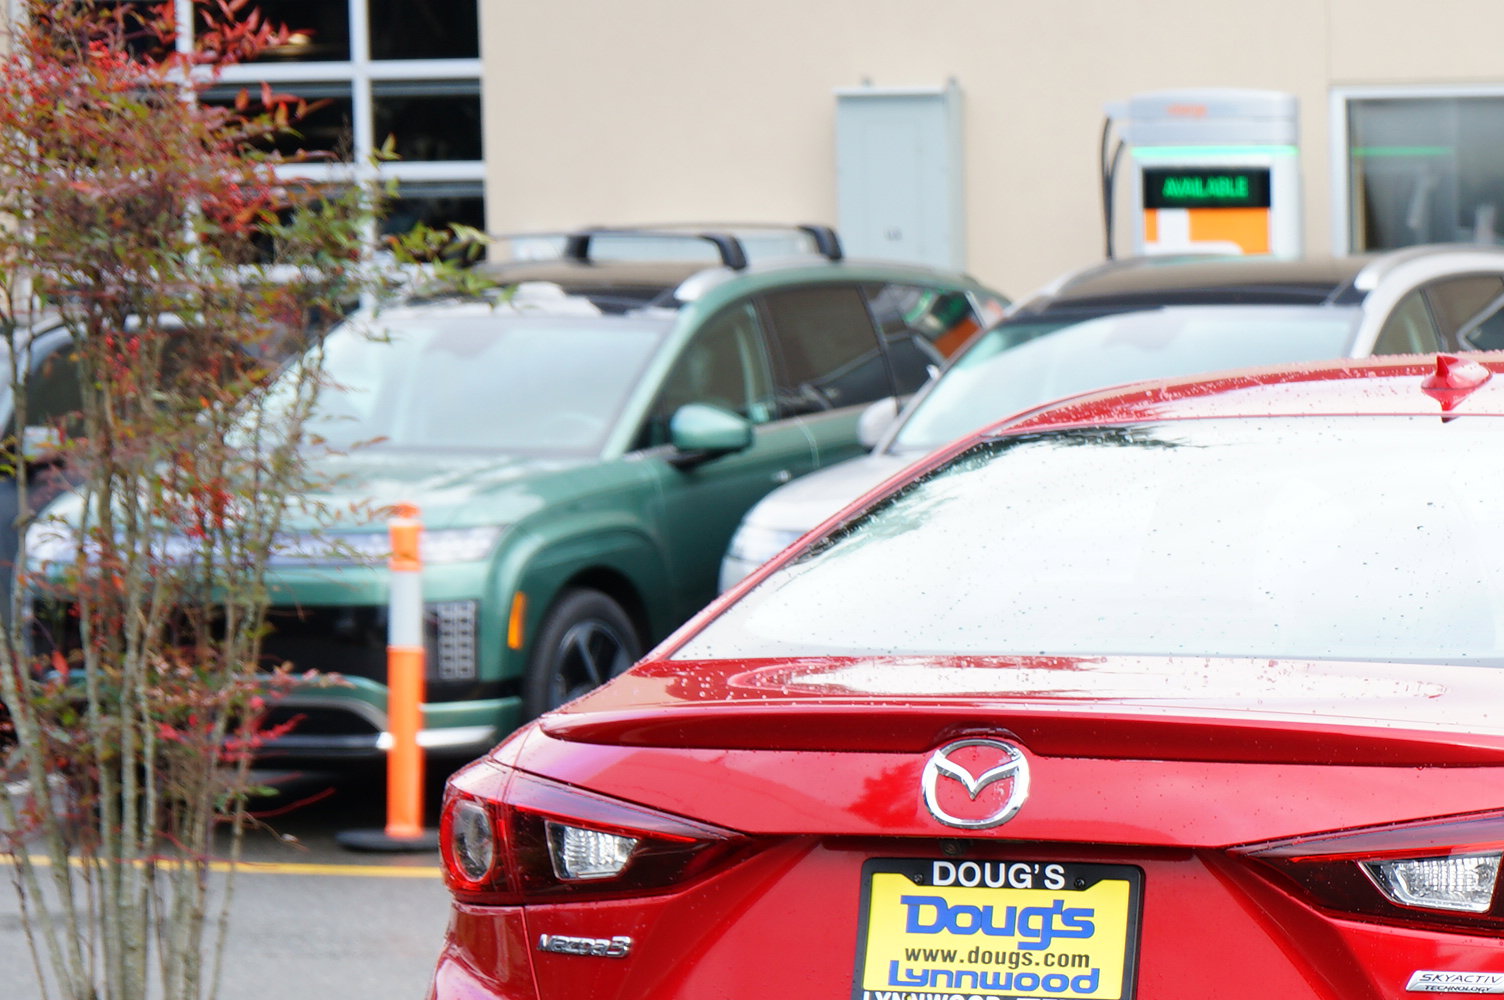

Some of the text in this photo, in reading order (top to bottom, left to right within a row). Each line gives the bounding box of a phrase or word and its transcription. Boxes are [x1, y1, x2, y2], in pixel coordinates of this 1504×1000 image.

[1163, 177, 1248, 197] AVAILABLE
[932, 861, 1066, 890] DOUG'S
[900, 895, 1095, 950] Doug's
[905, 946, 1090, 969] www.dougs.com
[888, 960, 1100, 993] Lynnwood
[1419, 973, 1503, 984] SKYACTIV
[1424, 984, 1493, 993] TECHNOLOGY
